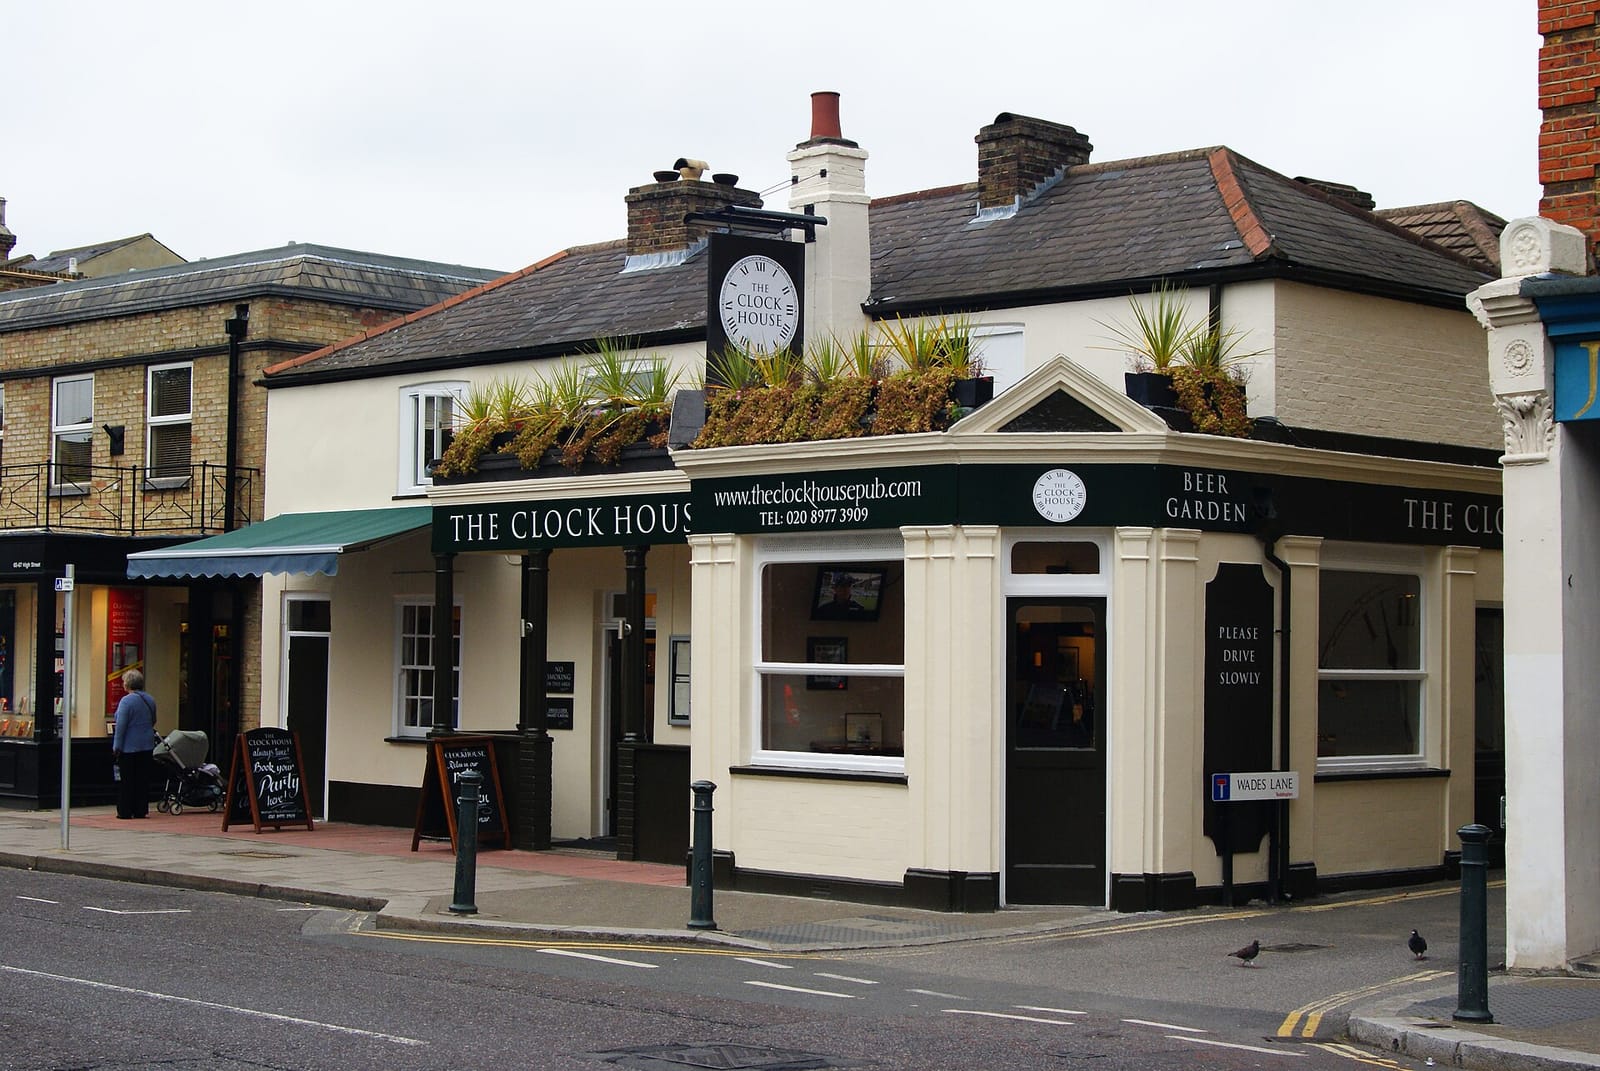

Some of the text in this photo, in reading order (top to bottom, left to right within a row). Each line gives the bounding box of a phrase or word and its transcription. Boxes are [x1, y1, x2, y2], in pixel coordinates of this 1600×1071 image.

[751, 282, 769, 293] THE
[737, 293, 782, 311] CLOCK
[737, 311, 783, 328] HOUSE
[1574, 341, 1600, 420] J
[1183, 471, 1229, 494] BEER
[714, 476, 922, 510] www.theclockhousepub.com
[1044, 489, 1075, 497] CLOCK
[1044, 497, 1076, 505] HOUSE
[759, 507, 869, 526] TEL: 020 8977 3909
[1166, 497, 1246, 522] GARDEN
[1403, 498, 1453, 531] THE
[449, 512, 500, 542] THE
[511, 506, 605, 540] CLOCK
[1219, 626, 1259, 640] PLEASE
[1223, 649, 1255, 663] DRIVE
[546, 673, 572, 681] SMOKING
[554, 665, 564, 673] NO
[1219, 671, 1261, 685] SLOWLY
[253, 761, 295, 775] Book your
[258, 772, 299, 799] Party
[1237, 777, 1294, 791] WADES LANE
[267, 790, 287, 807] here!
